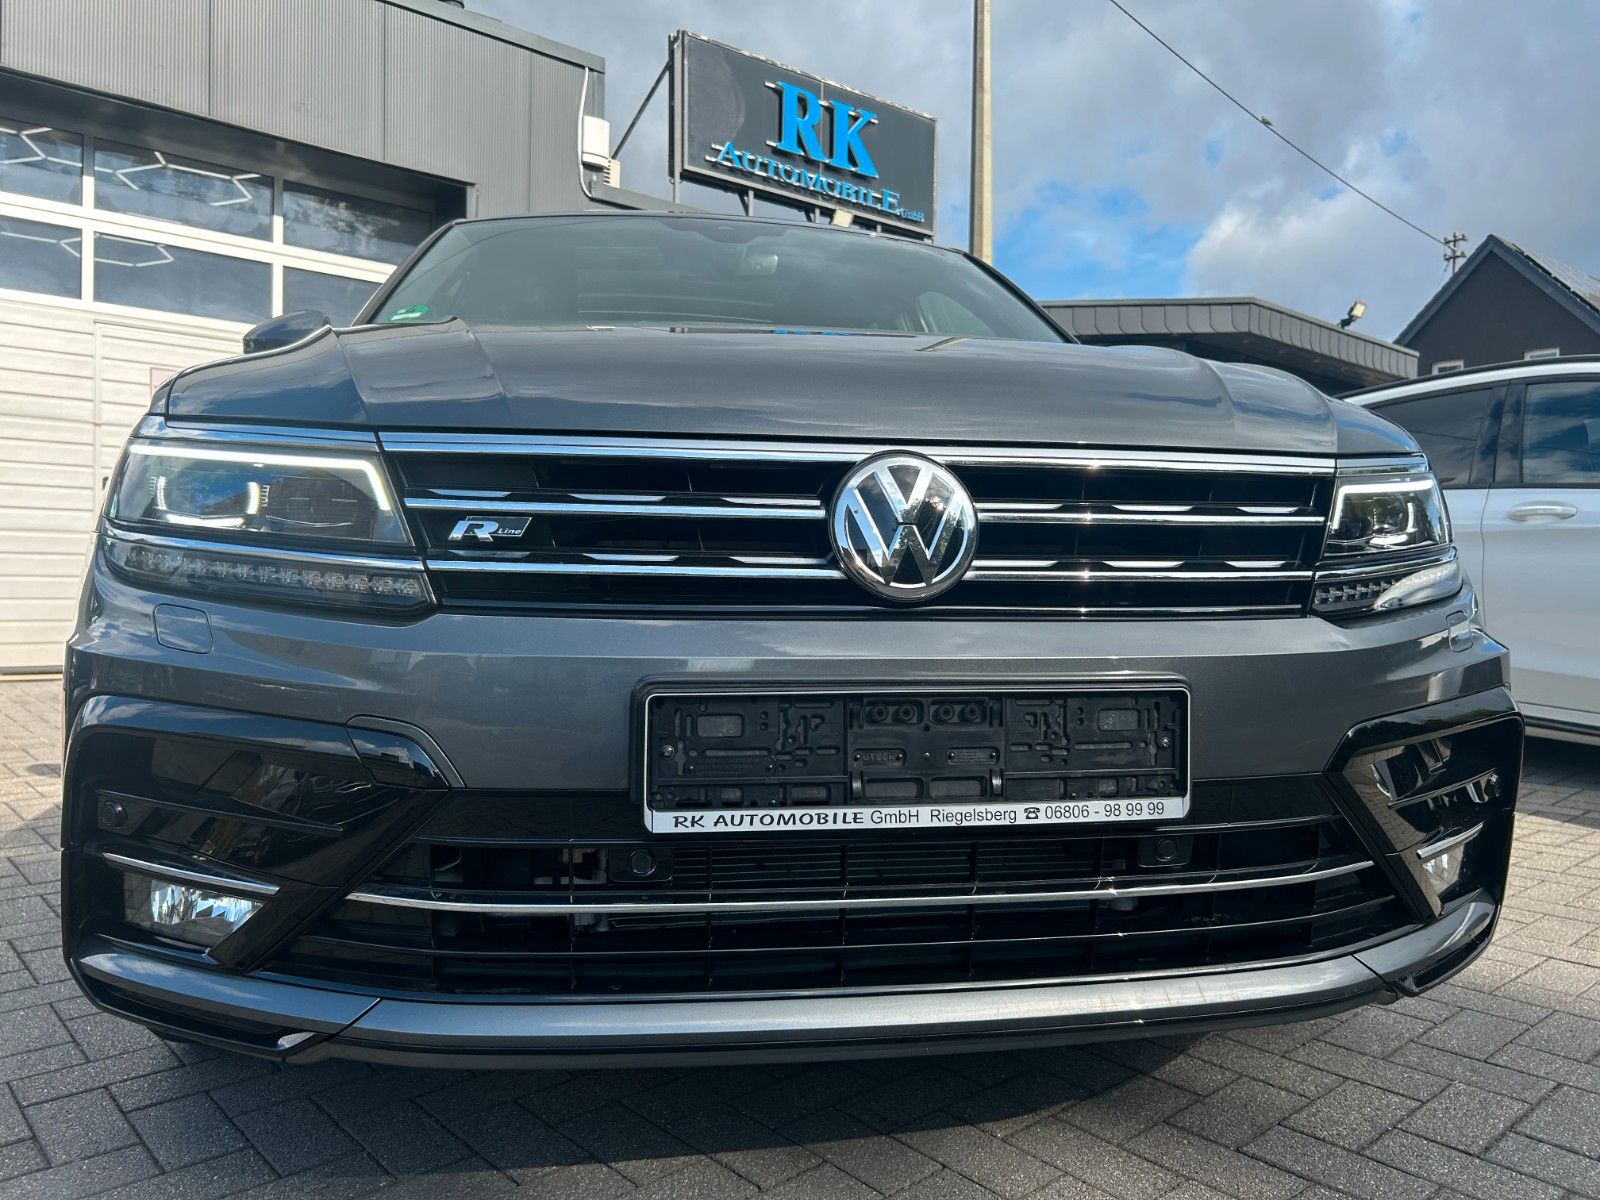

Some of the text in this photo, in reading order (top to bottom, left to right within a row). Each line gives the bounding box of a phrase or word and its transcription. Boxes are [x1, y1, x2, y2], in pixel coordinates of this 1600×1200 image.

[765, 81, 879, 178] RK
[705, 141, 901, 215] AUTOMOBILE
[448, 520, 522, 542] R Line
[672, 814, 706, 829] RK
[713, 811, 865, 828] AUTOMOBILE
[870, 809, 920, 825] GmbH
[930, 807, 1017, 826] Riegelsberg
[1044, 804, 1091, 820] 06806
[1104, 802, 1122, 817] 98
[1125, 801, 1143, 816] 99
[1147, 800, 1165, 816] 99
